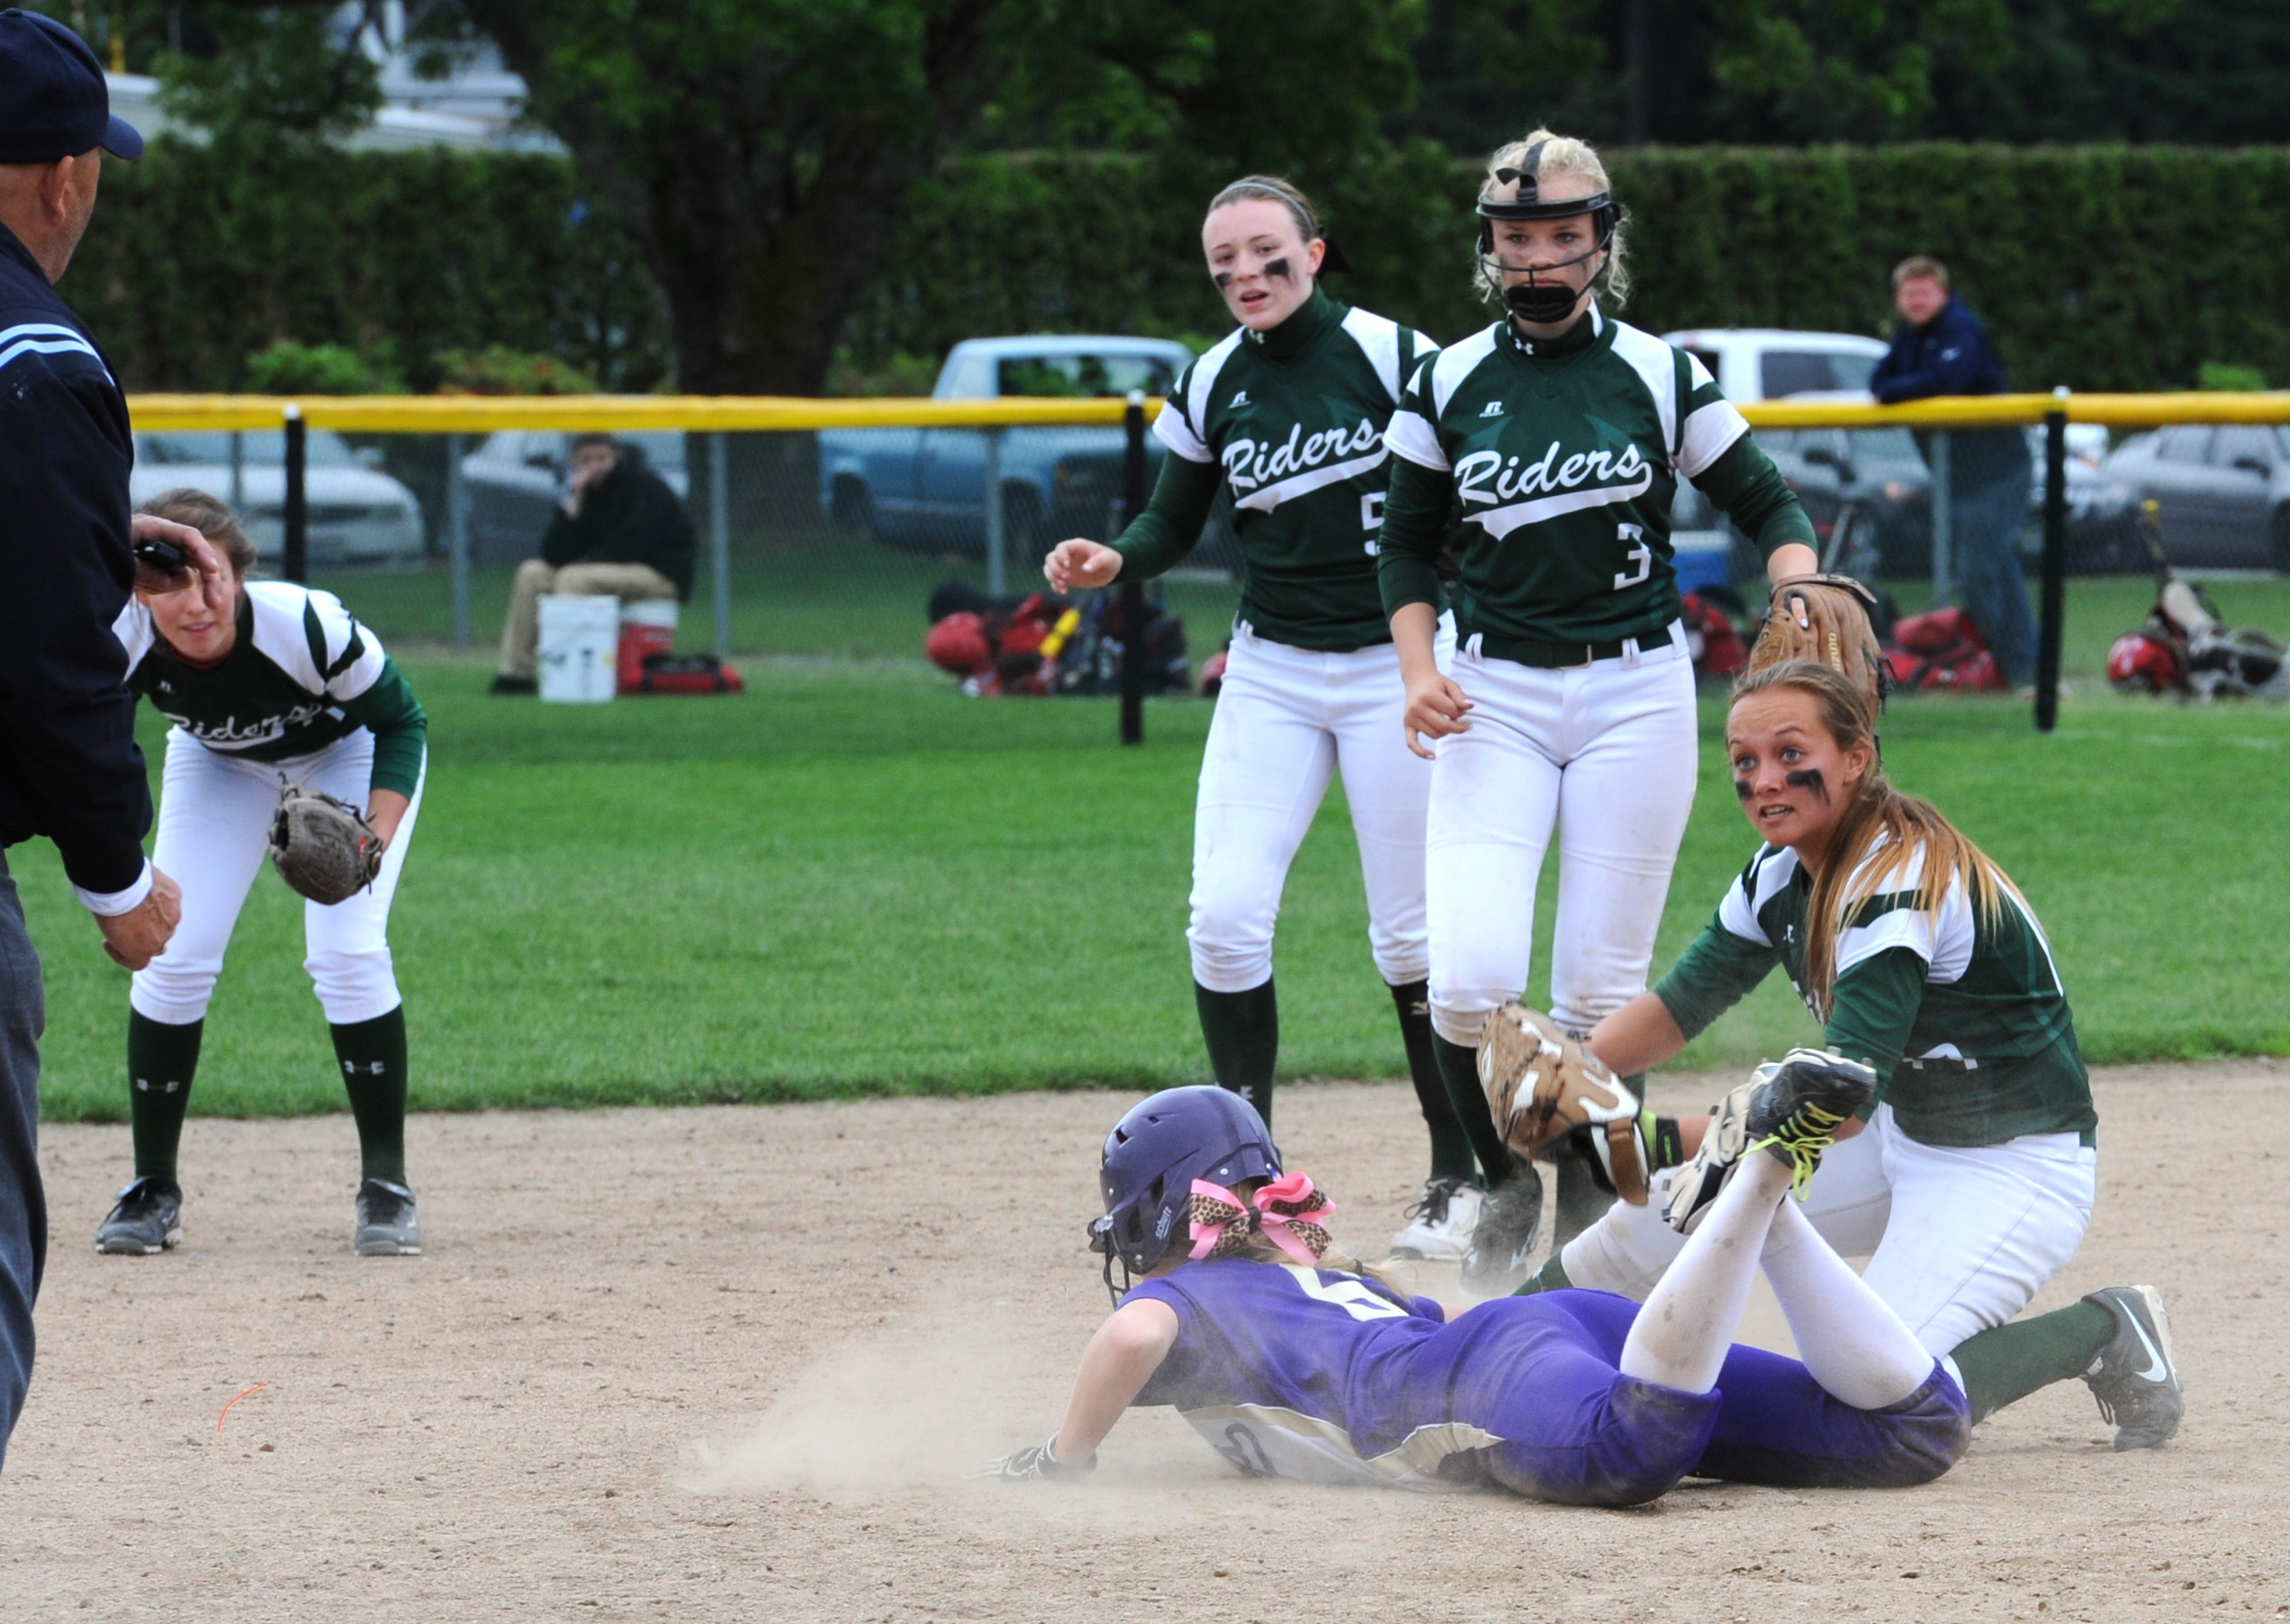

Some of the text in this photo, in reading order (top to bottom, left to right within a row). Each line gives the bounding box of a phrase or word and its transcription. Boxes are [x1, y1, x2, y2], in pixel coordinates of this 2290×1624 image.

[1222, 418, 1384, 497] Riders
[1454, 440, 1649, 507] Riders
[1613, 522, 1652, 591] 3
